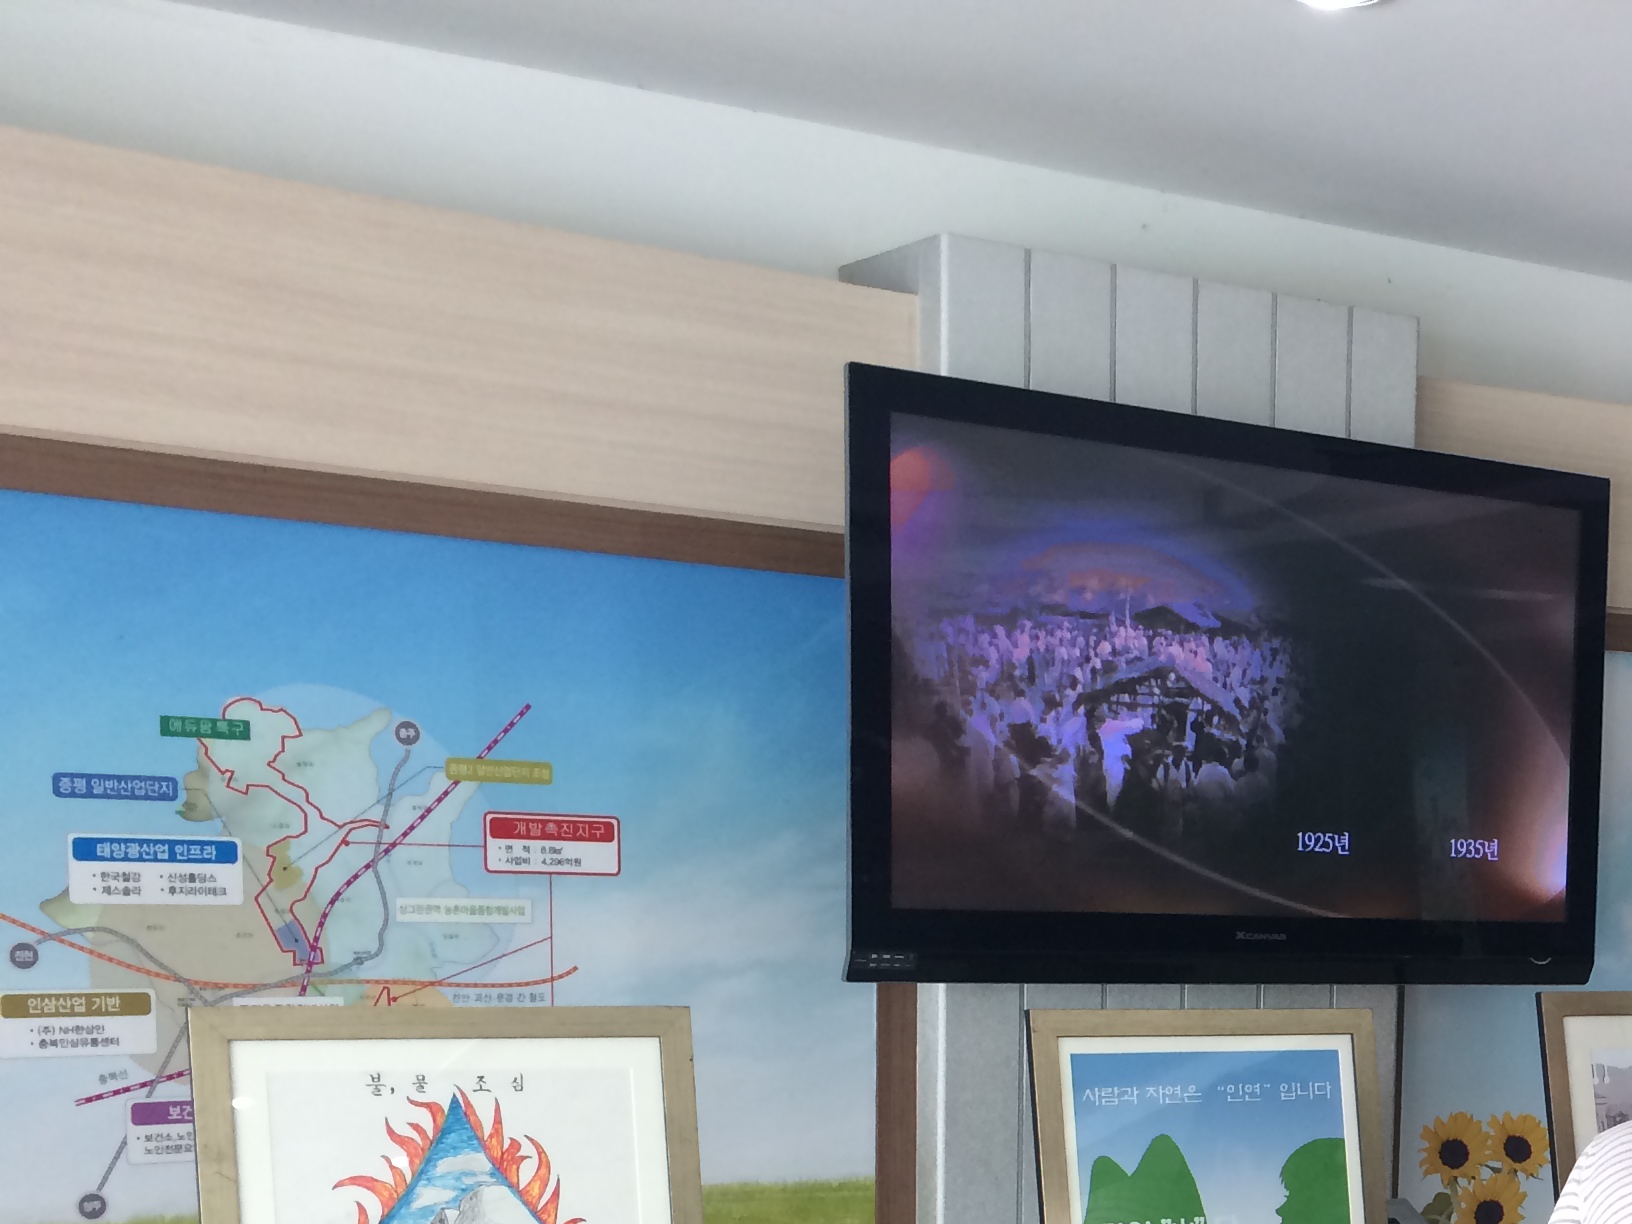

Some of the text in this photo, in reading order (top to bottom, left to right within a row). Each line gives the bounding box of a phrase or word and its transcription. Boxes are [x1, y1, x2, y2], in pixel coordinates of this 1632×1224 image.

[58, 777, 173, 797] 증평 일반산업단지
[513, 821, 605, 839] 개발촉진지구
[96, 842, 217, 861] 태양광산업 인프라
[1297, 831, 1350, 855] 1925년
[1449, 838, 1499, 861] 1935년
[27, 996, 121, 1014] 인삼산업 기반
[365, 1073, 526, 1096] 불, 물 조심
[1082, 1085, 1140, 1106] 사람과
[1145, 1084, 1203, 1104] 자연은
[1279, 1081, 1332, 1101] 입니다
